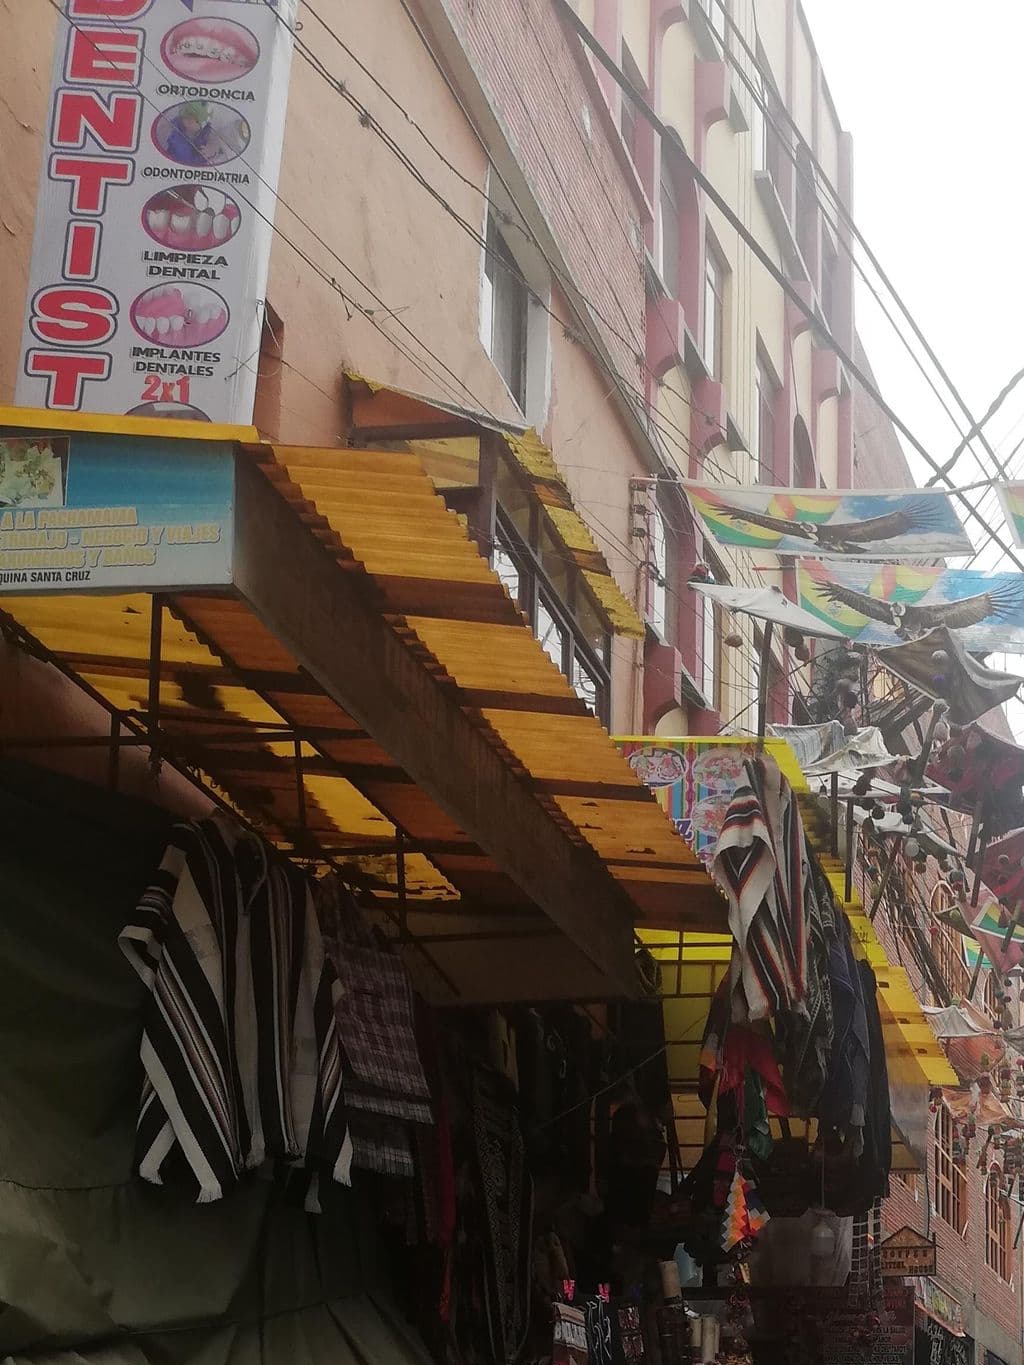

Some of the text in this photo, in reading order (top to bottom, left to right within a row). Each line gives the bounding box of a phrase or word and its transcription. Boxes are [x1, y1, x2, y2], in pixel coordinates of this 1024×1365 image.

[157, 84, 255, 101] ORTODONCIA
[143, 167, 250, 184] ODONTOPEDIATRIA
[144, 251, 228, 266] LIMPIEZA
[149, 266, 220, 280] DENTAL
[132, 347, 220, 362] IMPLANTES
[136, 361, 214, 377] DENTALES
[140, 375, 190, 402] 2x1
[31, 571, 62, 582] SANTA
[65, 571, 90, 581] CRUZ
